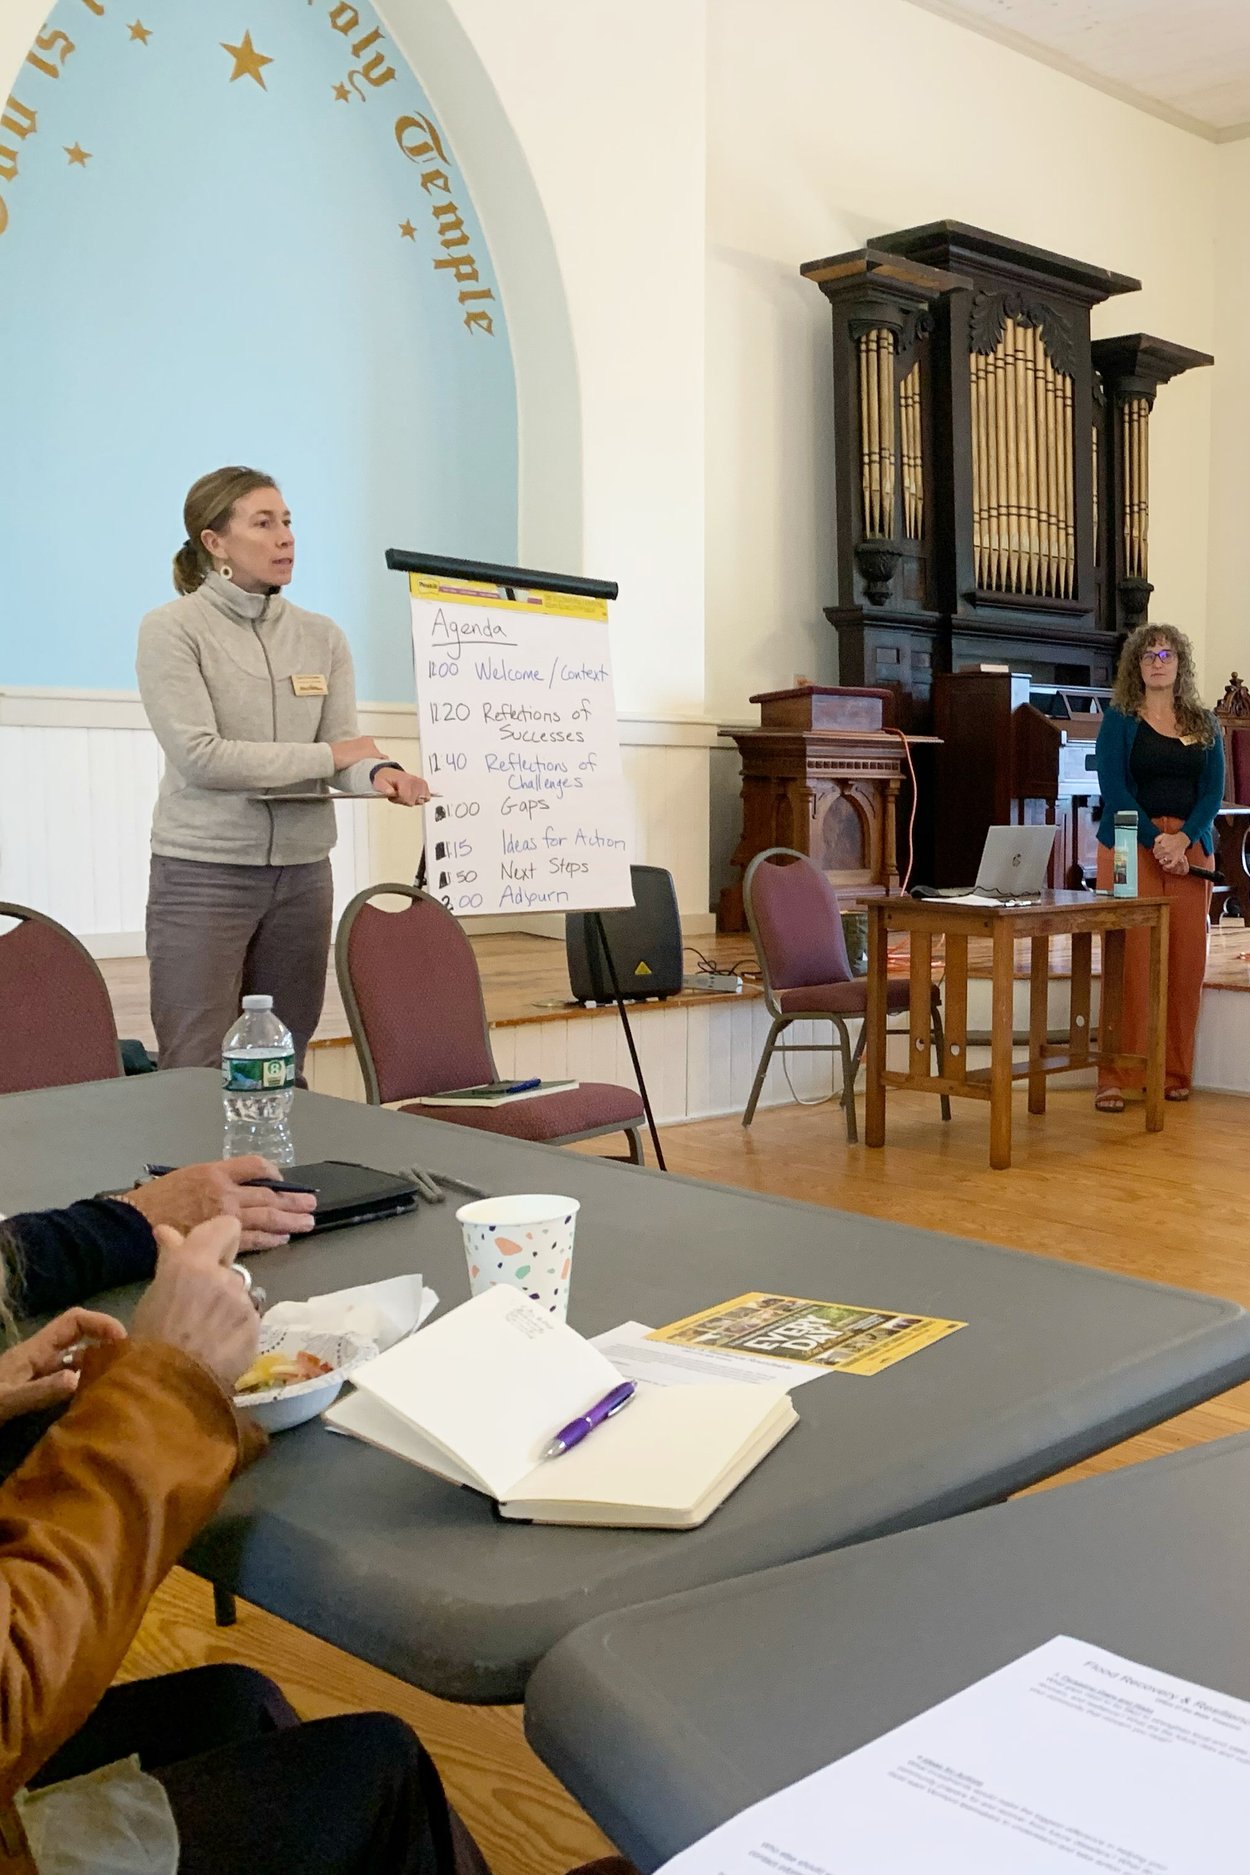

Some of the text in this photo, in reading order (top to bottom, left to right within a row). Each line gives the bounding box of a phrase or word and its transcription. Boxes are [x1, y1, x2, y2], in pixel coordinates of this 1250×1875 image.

[308, 0, 496, 337] oly Temple
[431, 608, 507, 660] Agenda
[474, 655, 545, 682] Welcome
[482, 701, 561, 724] Reflections
[571, 698, 592, 721] of
[499, 723, 585, 743] Successes
[484, 752, 568, 773] Reflections
[578, 751, 598, 772] of
[507, 773, 584, 800] Challenges
[500, 796, 550, 821] Gaps
[502, 828, 538, 855] Ideas
[543, 825, 567, 849] for
[574, 828, 627, 851] Action
[501, 860, 537, 881] Next
[549, 857, 590, 879] Steps
[743, 1314, 831, 1351] EVERY
[781, 1322, 844, 1351] DAY
[1119, 1675, 1176, 1700] Recovery
